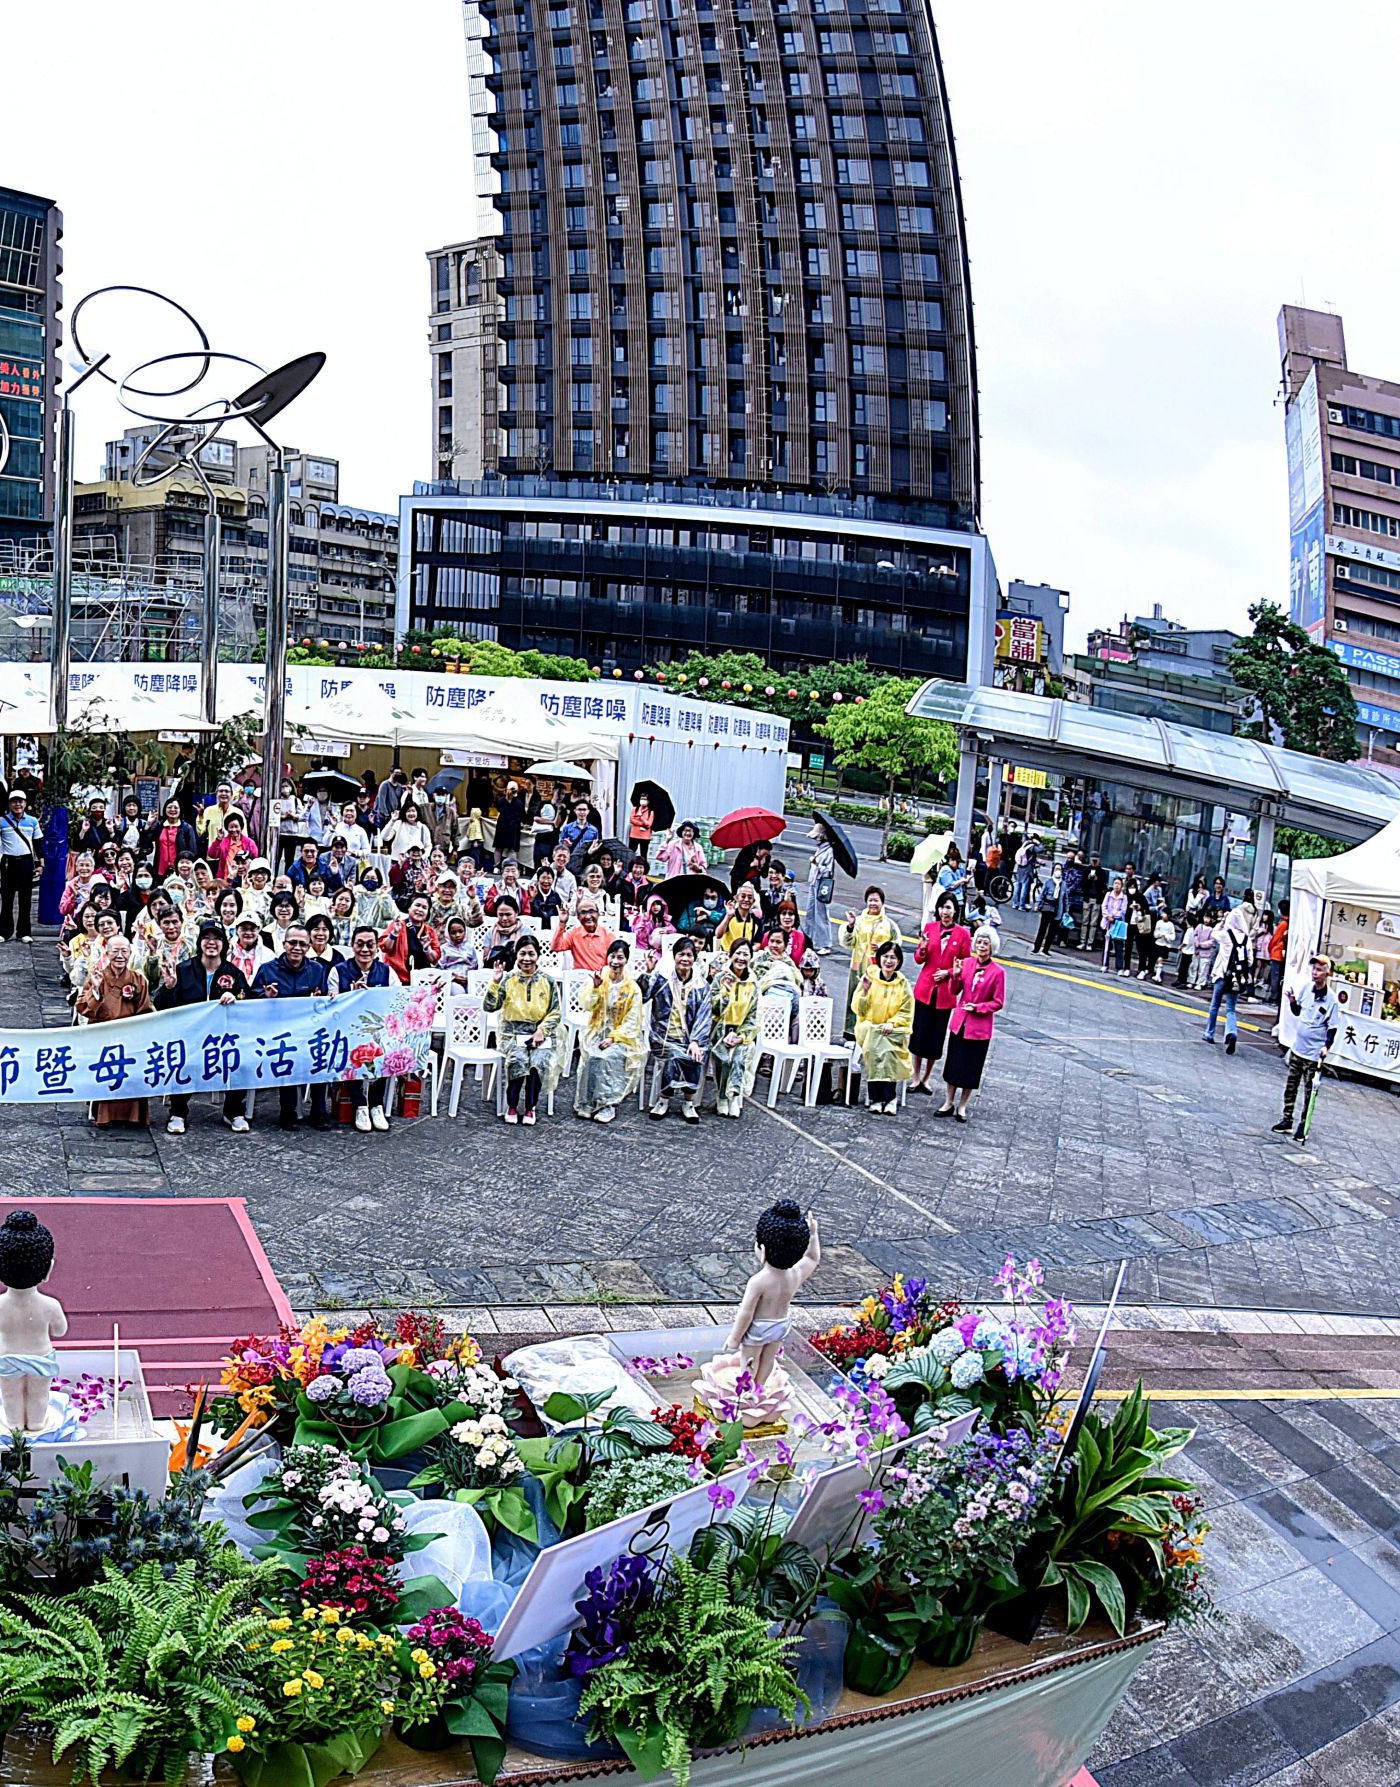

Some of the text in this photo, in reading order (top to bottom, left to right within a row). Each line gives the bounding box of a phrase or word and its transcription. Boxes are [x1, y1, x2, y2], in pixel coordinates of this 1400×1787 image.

[134, 674, 198, 693] 防塵降噪
[425, 685, 497, 709] 防塵降
[540, 693, 627, 722] 防塵降噪
